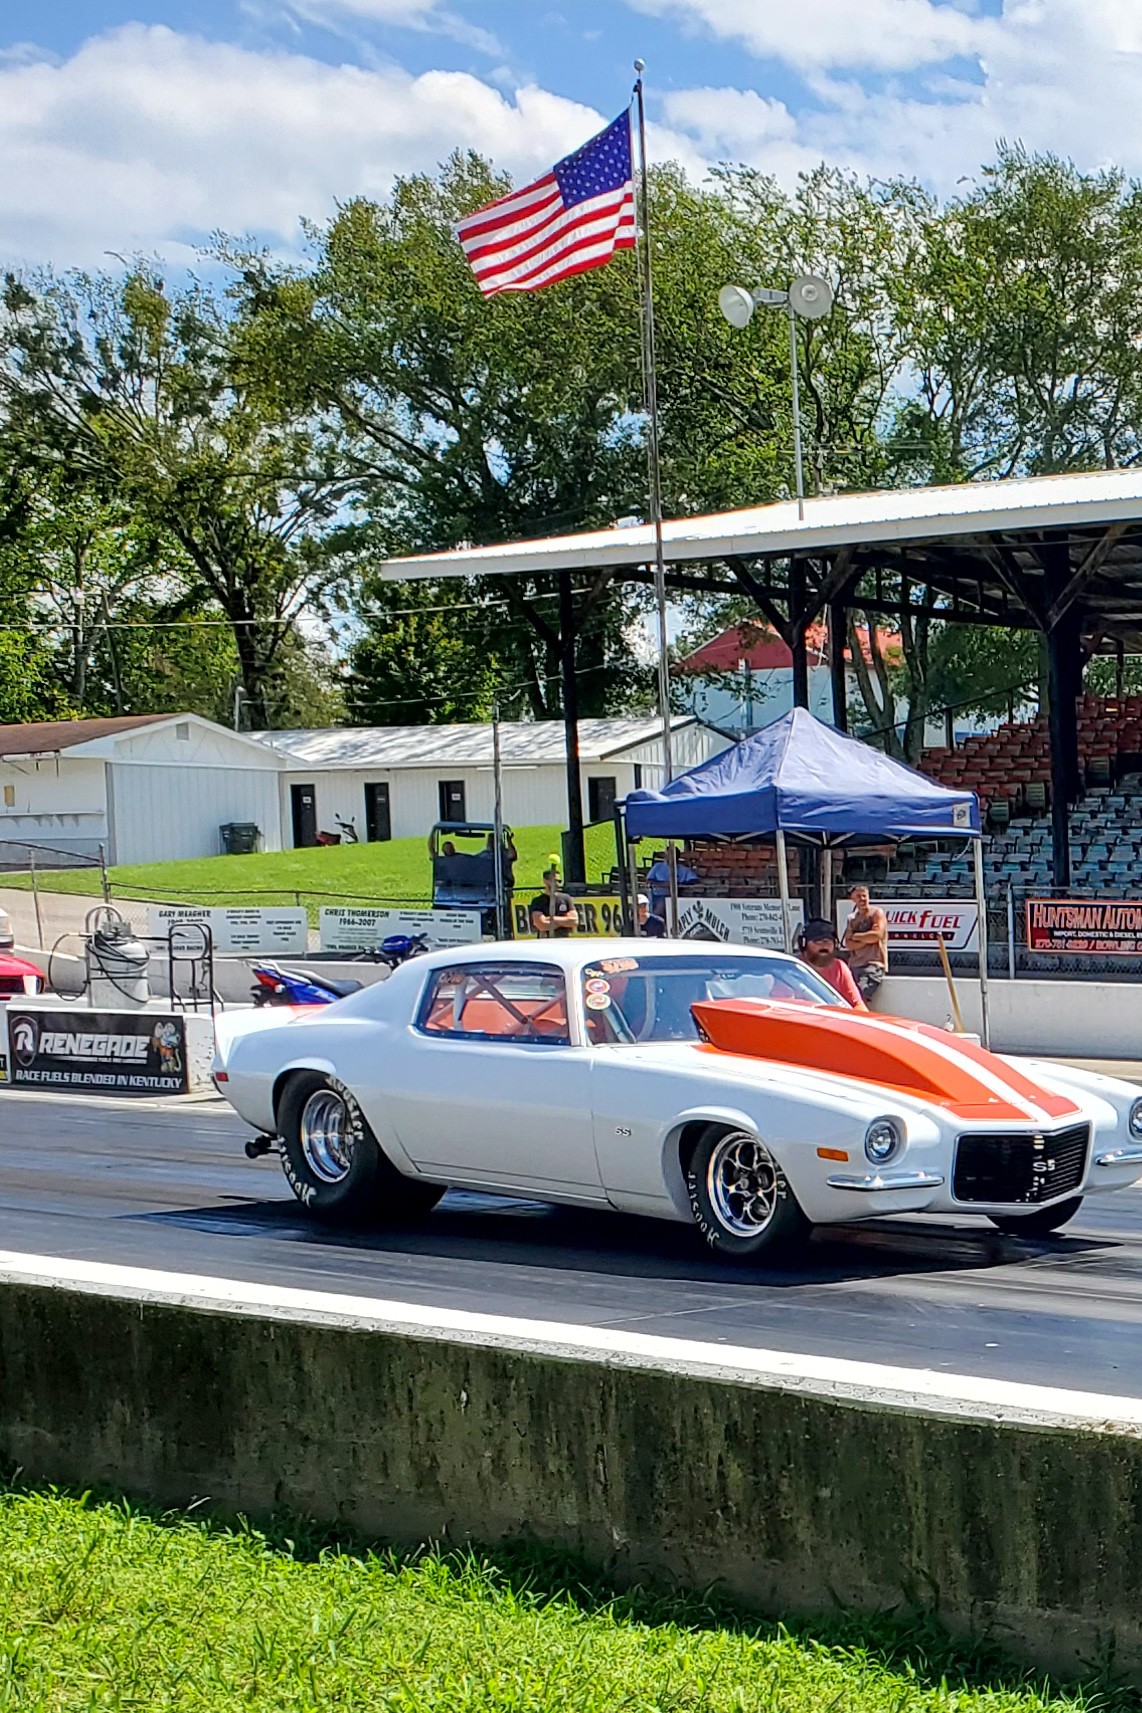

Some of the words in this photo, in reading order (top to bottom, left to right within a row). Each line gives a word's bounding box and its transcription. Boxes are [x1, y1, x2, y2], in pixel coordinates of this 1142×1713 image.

[159, 910, 176, 918] GARY
[177, 910, 211, 919] MEAGHER
[324, 908, 345, 916] CHRIS
[347, 909, 390, 918] THOMERSON
[885, 911, 917, 923] UICK
[1032, 903, 1102, 929] HUNTSMAN
[339, 918, 377, 927] 1966-2007
[704, 908, 731, 941] MULCH
[1096, 940, 1136, 950] BOWLING
[38, 1032, 151, 1058] RENEGADE
[16, 1069, 40, 1081] RACE
[41, 1070, 70, 1083] FUELS
[71, 1072, 116, 1085] BLENDED
[117, 1075, 129, 1086] IN
[129, 1076, 183, 1089] KENTUCKY
